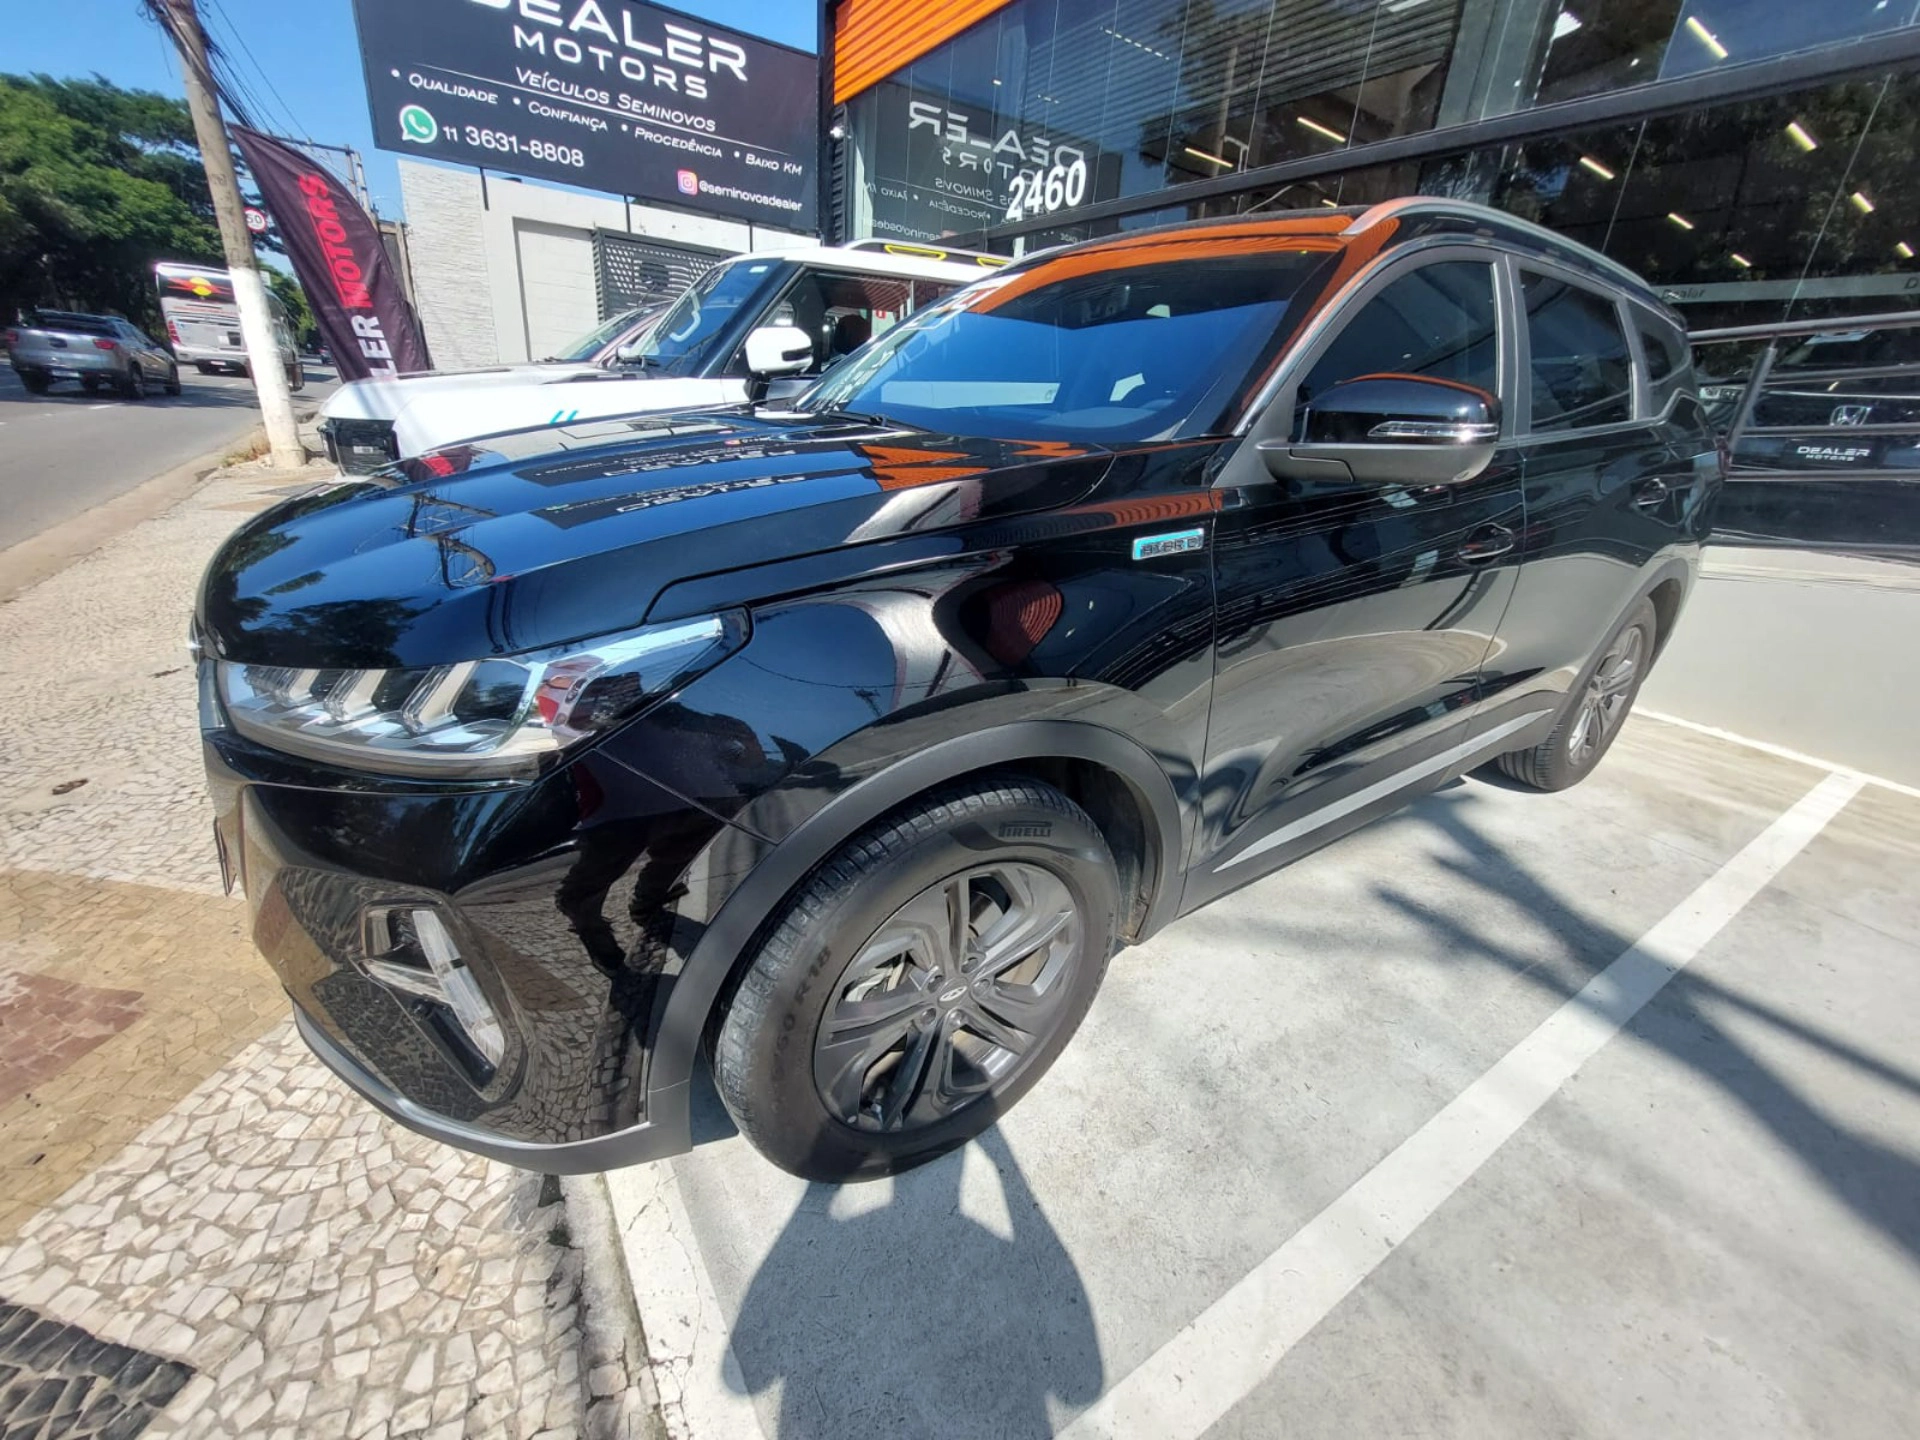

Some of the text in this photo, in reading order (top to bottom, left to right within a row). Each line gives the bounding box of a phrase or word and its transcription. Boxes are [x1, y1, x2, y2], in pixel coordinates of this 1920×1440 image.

[512, 24, 709, 99] MOTORS
[408, 72, 803, 176] QUALIDADE CONFIANÇA PROCEDÊNCIA BAIXO KM
[515, 66, 717, 133] VEÍCULOS SEMINOVOS
[442, 125, 585, 168] 11 3631-8808
[698, 179, 803, 213] @seminovosdealer
[1005, 159, 1087, 220] 2460
[297, 173, 373, 309] MOTORS
[1796, 446, 1870, 457] DEALER
[1805, 454, 1855, 462] MOTORS
[998, 820, 1053, 838] PIRELLI
